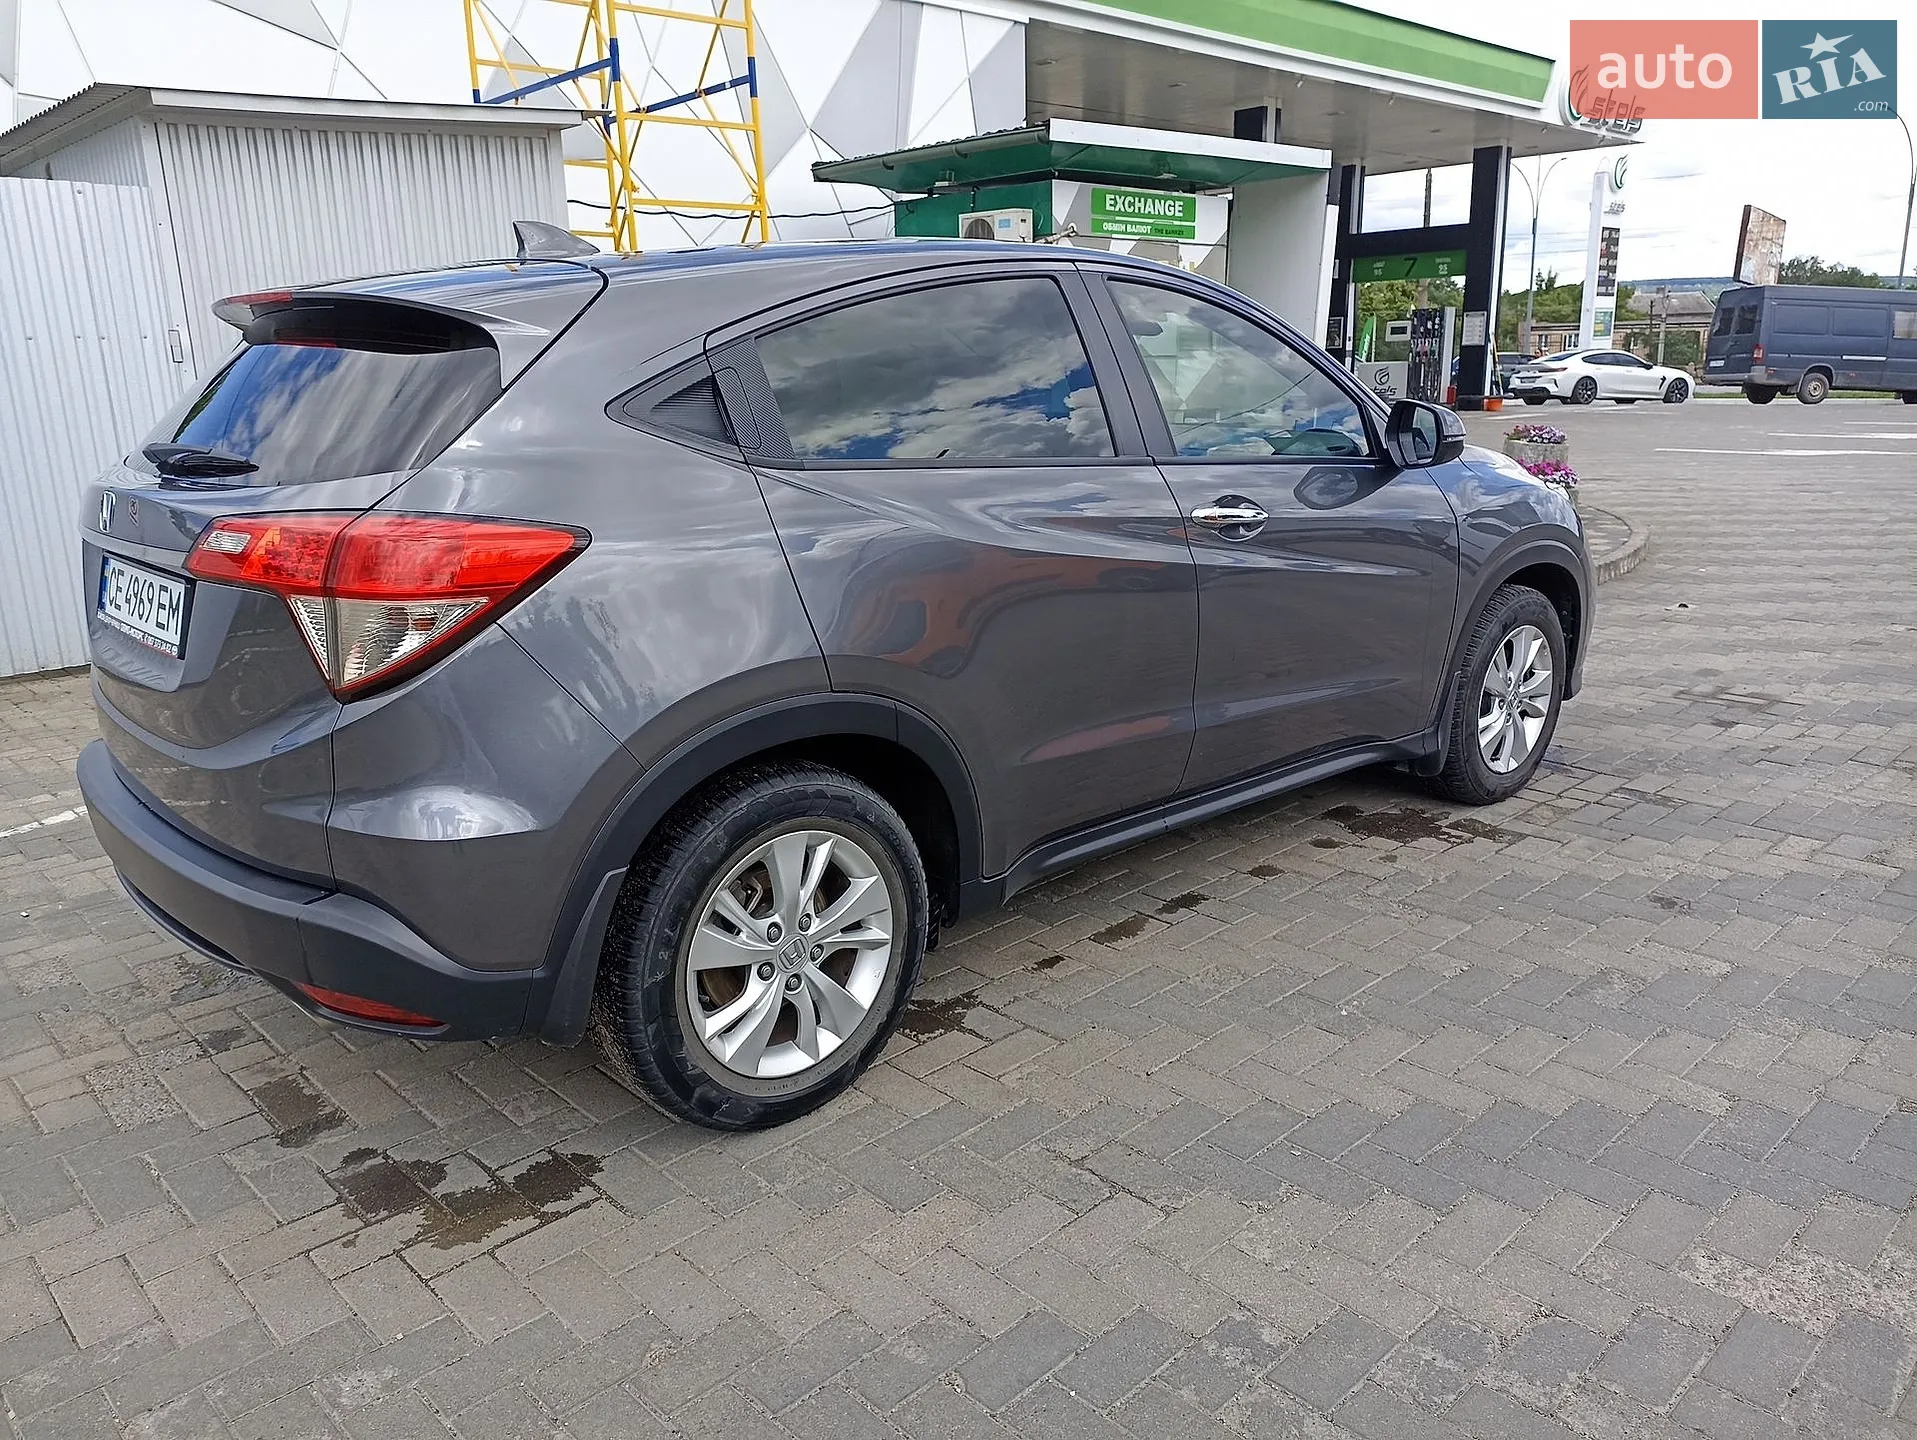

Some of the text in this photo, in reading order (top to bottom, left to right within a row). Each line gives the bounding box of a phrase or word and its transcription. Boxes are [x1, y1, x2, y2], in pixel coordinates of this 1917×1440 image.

[1105, 194, 1184, 217] EXCHANGE
[1126, 224, 1152, 234] ВАЛЮТ
[1403, 257, 1418, 278] 7
[108, 566, 182, 636] CE 4969 EM
